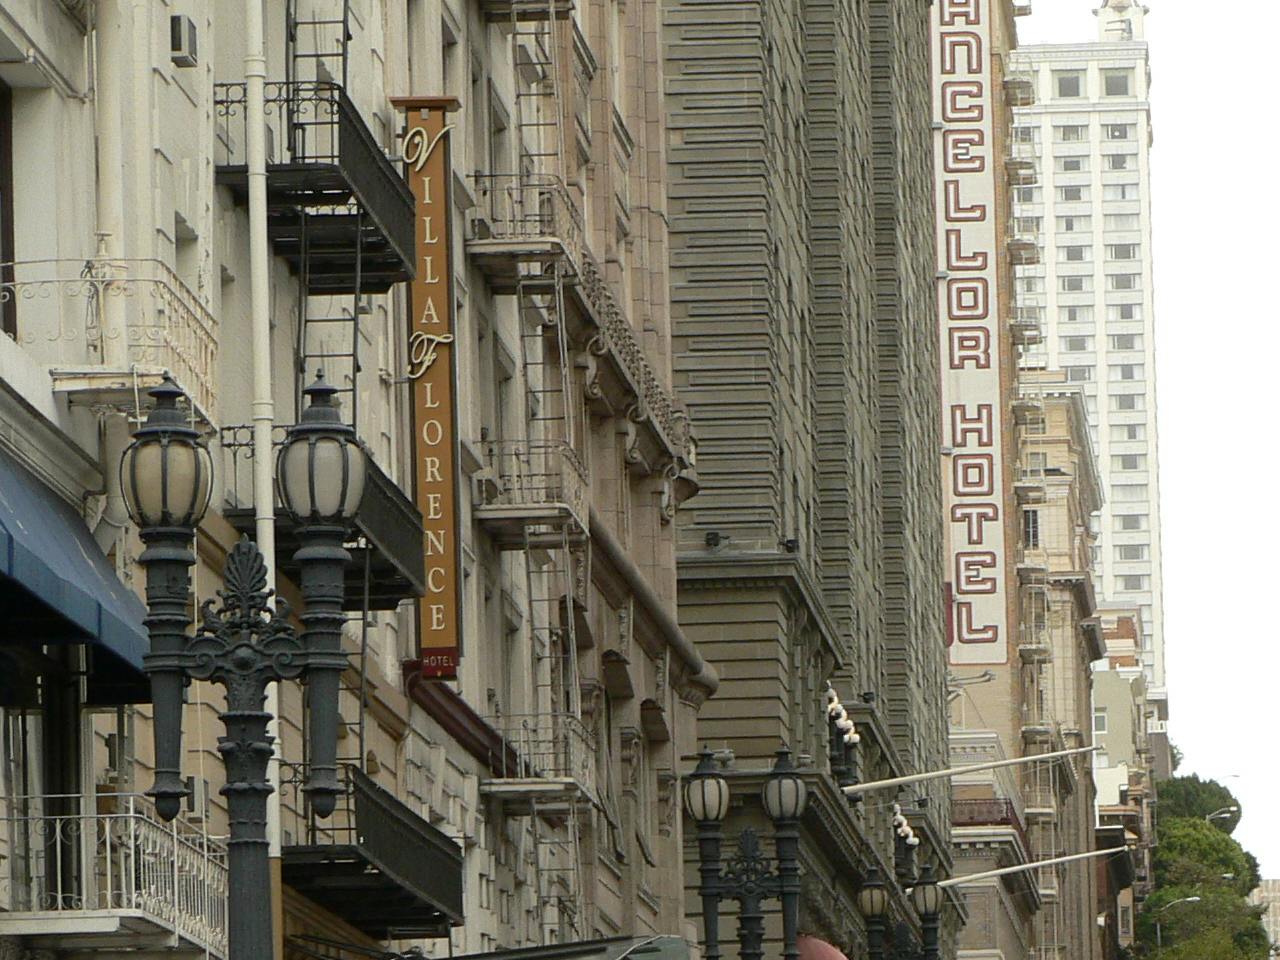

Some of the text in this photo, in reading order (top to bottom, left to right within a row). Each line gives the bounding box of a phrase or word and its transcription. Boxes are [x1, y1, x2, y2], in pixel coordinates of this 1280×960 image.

[402, 124, 455, 631] VILLA FLORENCE
[938, 0, 998, 644] ANCELLOR HOTEL
[423, 658, 454, 667] HOTEL
